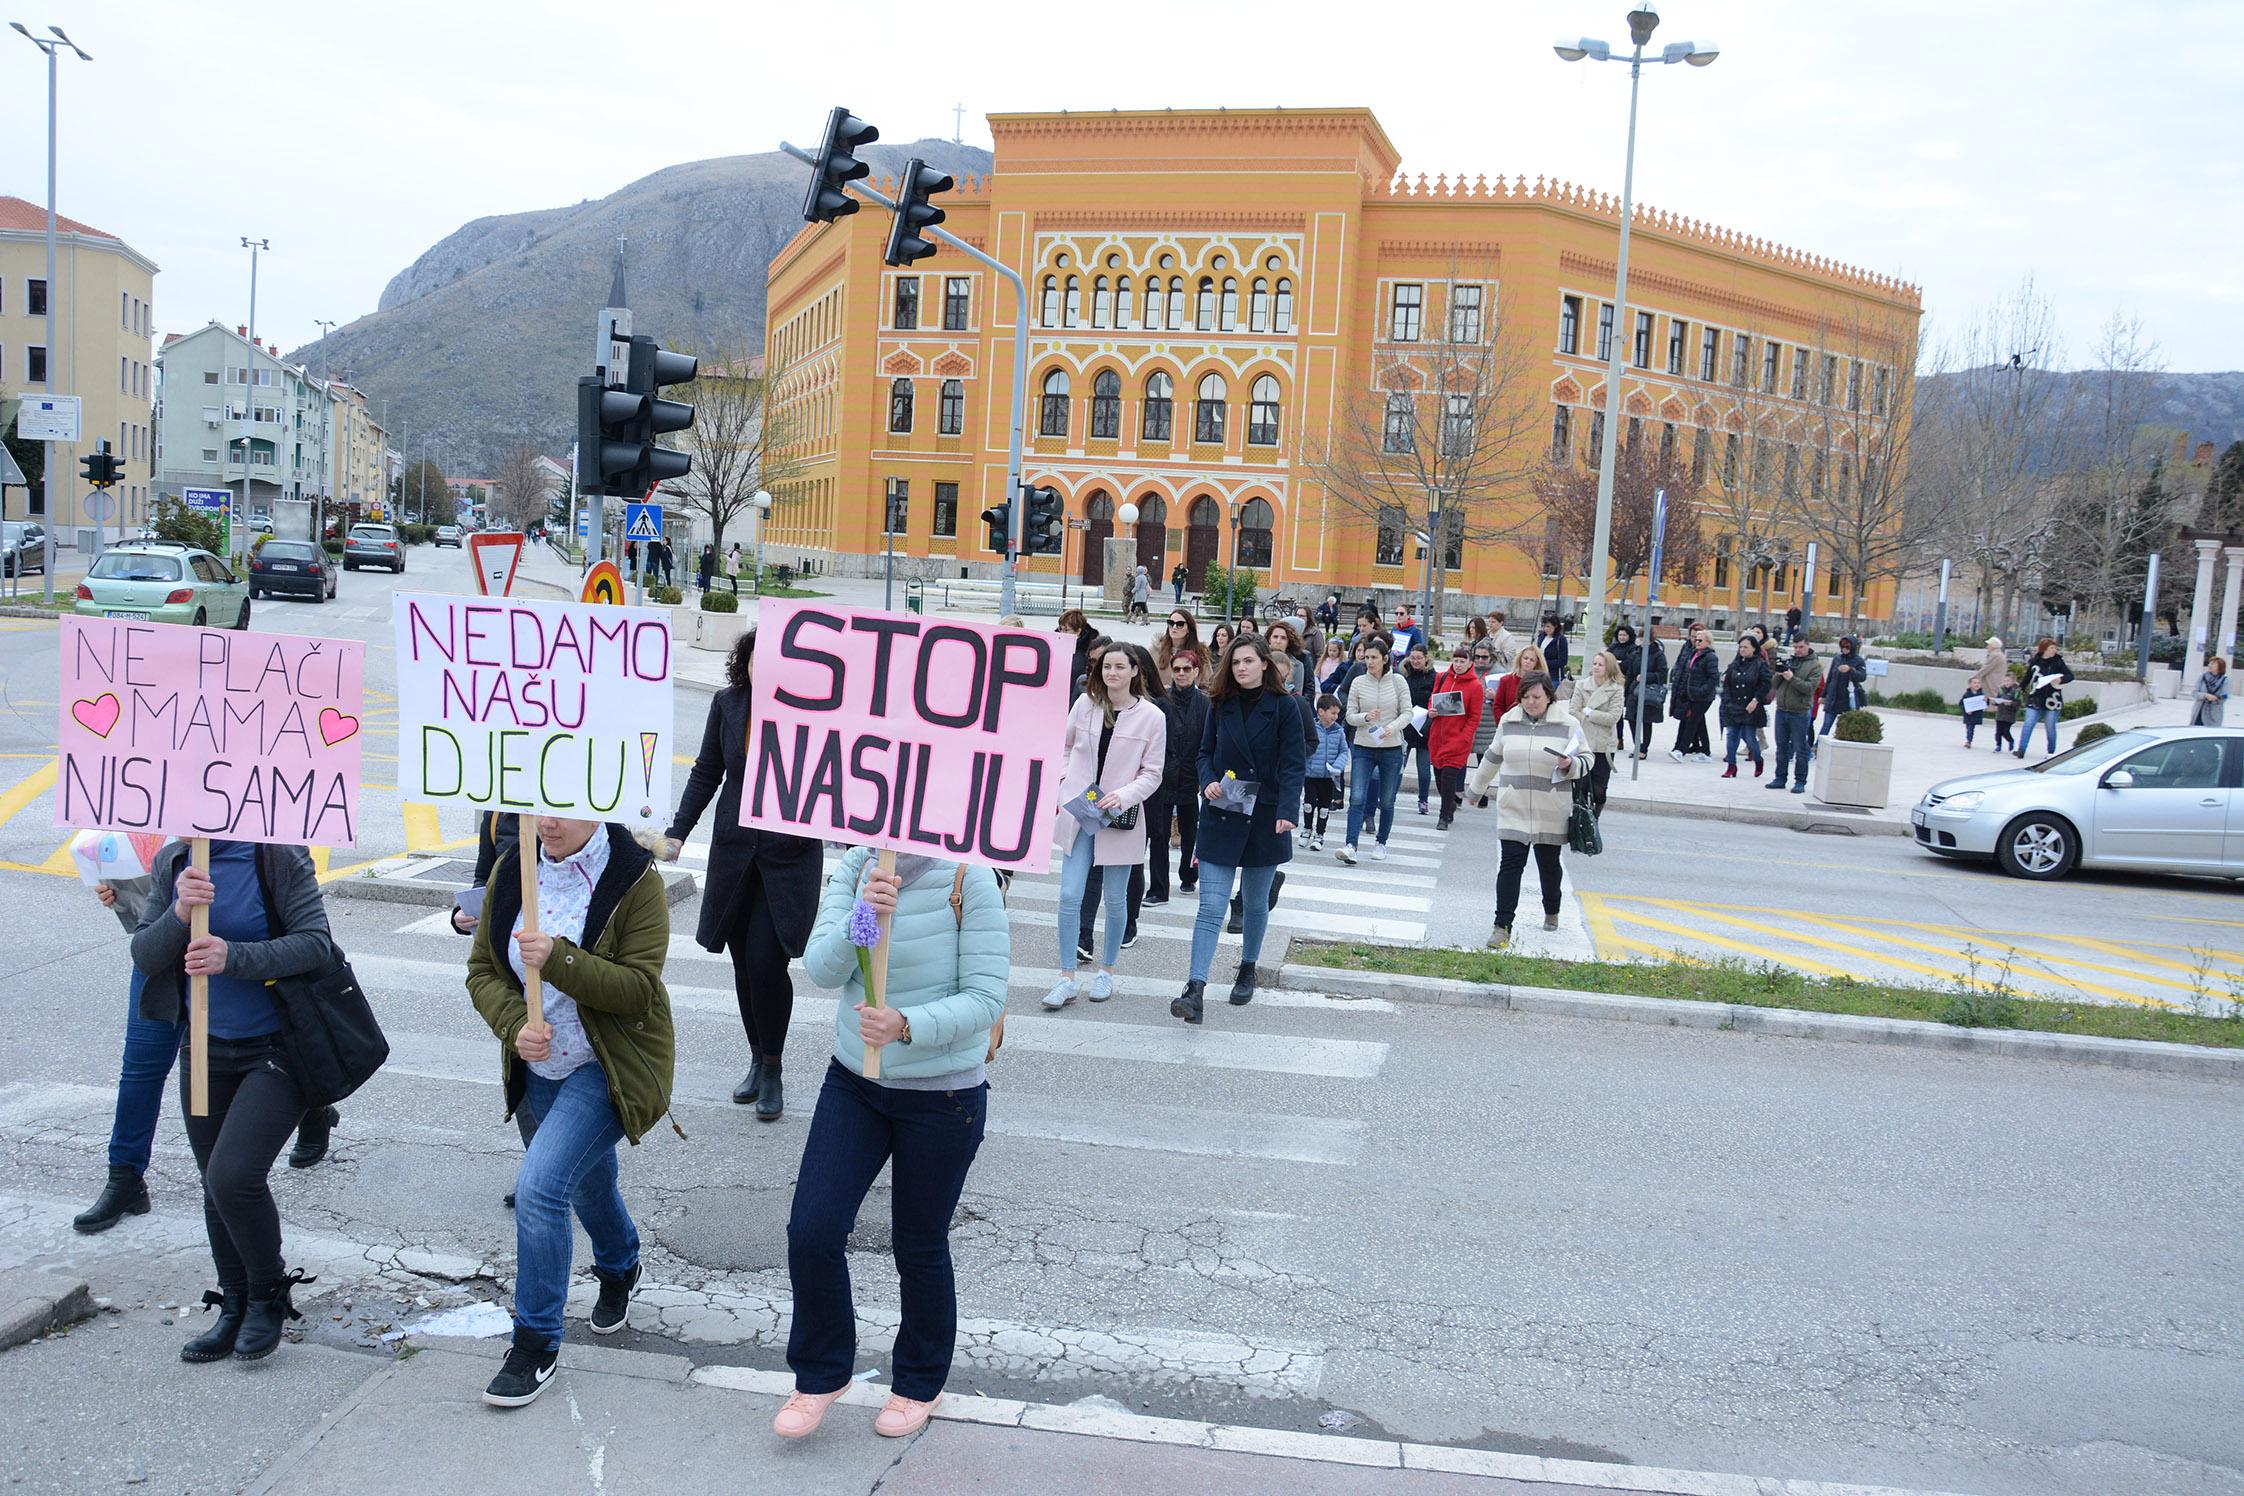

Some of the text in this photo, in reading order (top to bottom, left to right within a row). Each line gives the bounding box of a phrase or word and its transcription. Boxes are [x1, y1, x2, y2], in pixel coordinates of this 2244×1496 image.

[199, 492, 212, 500] IMA
[76, 625, 343, 700] NE PLAČI
[408, 601, 671, 684] NEDAMO
[773, 608, 1052, 735] STOP
[131, 688, 313, 760] MAMA
[441, 666, 588, 729] NAŠU
[63, 752, 355, 844] NISI SAMA
[421, 724, 661, 819] DJECU!
[750, 718, 1044, 864] NASILJU
